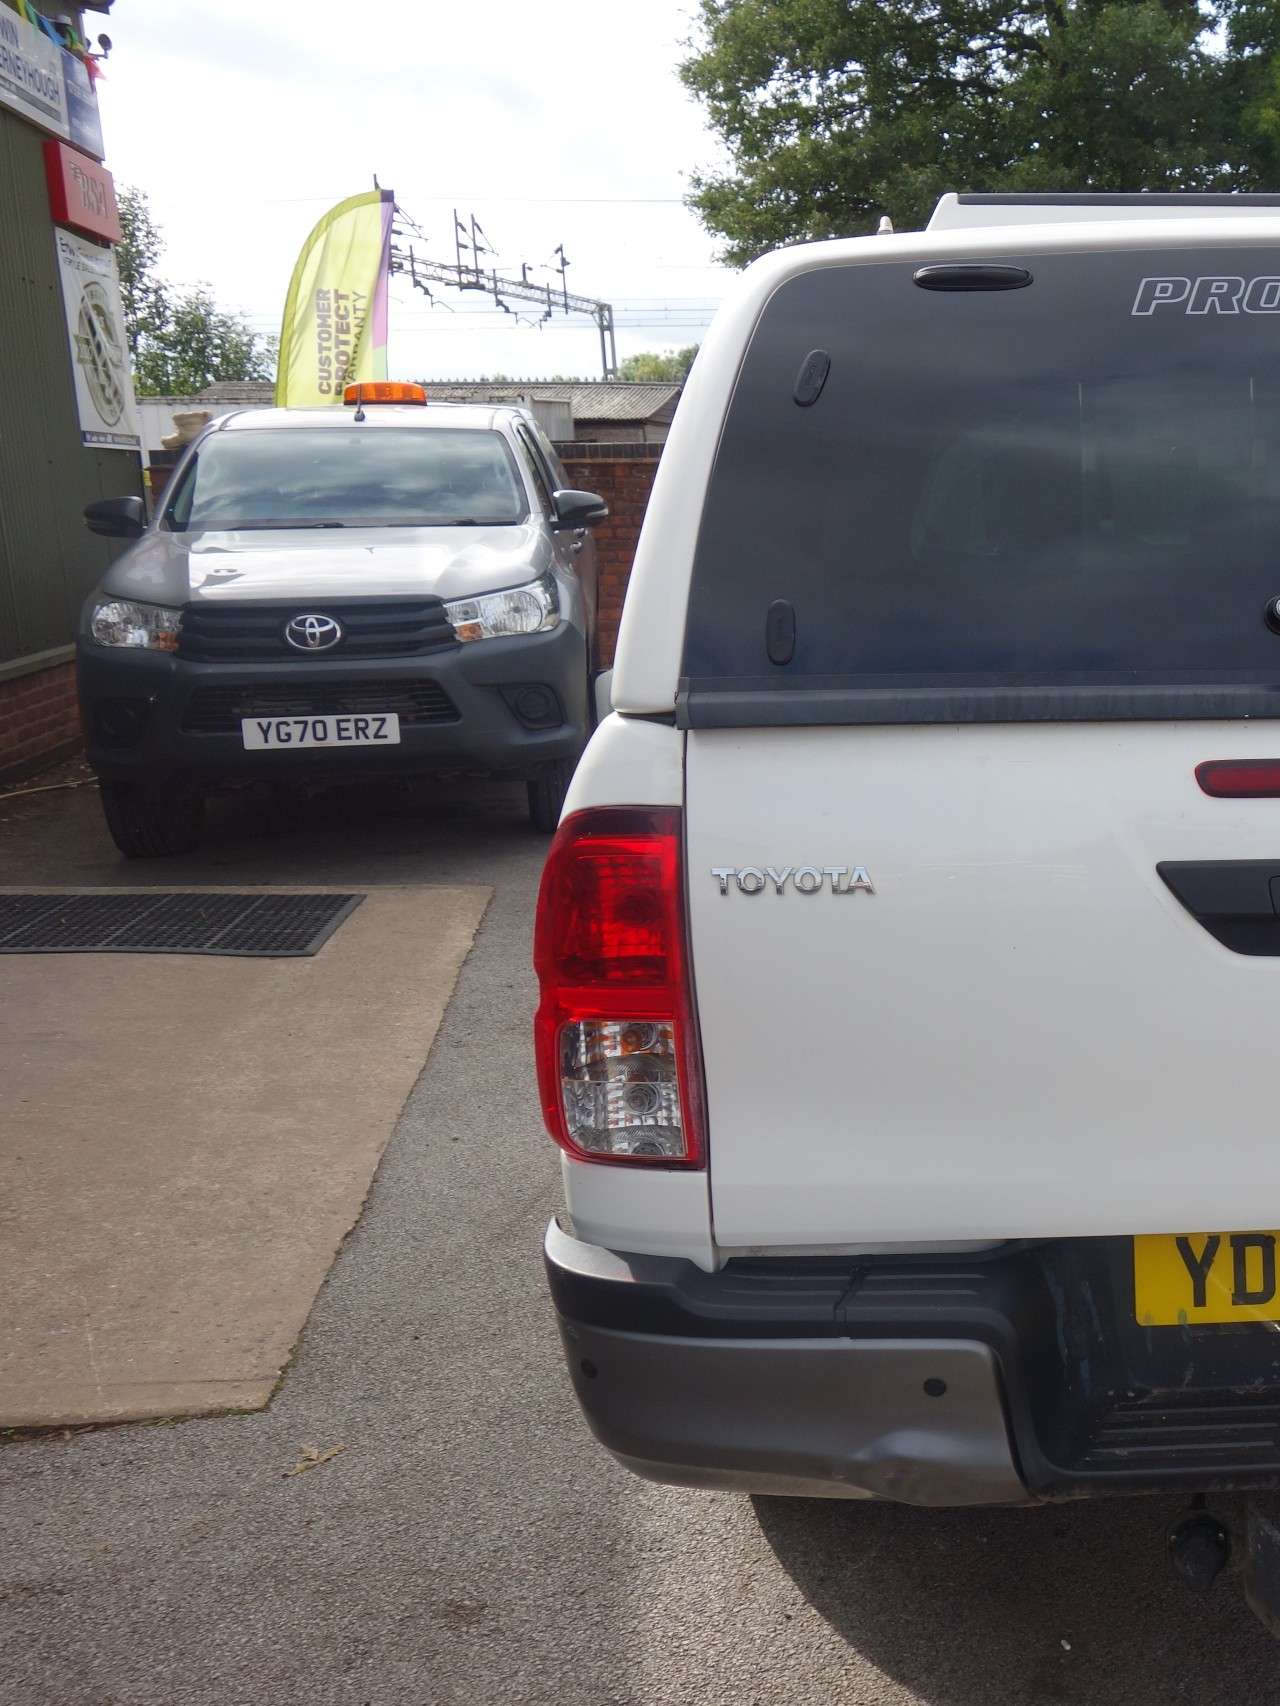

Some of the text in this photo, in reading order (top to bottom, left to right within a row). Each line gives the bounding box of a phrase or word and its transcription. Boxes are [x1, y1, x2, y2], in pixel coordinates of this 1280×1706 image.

[316, 288, 333, 395] CUSTOMER
[334, 288, 351, 396] PROTECT
[257, 717, 388, 744] YG70 ERZ
[711, 865, 877, 897] TOYOTA
